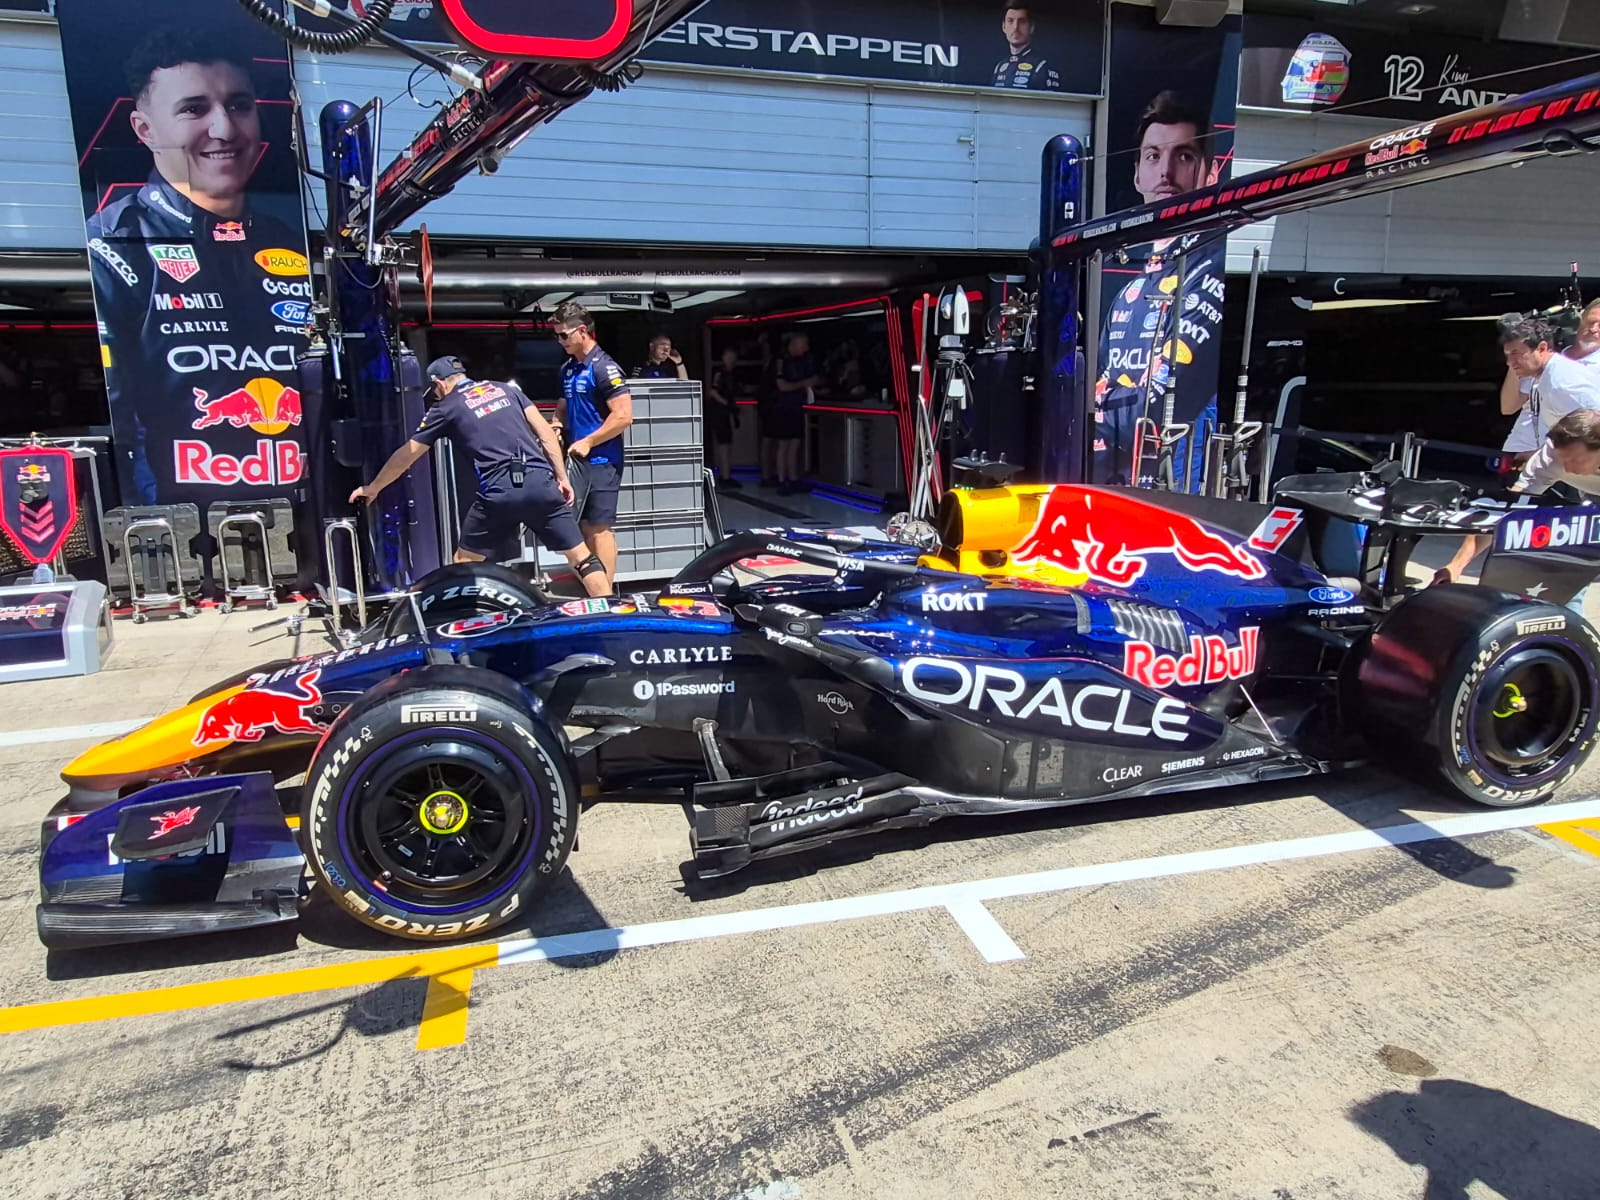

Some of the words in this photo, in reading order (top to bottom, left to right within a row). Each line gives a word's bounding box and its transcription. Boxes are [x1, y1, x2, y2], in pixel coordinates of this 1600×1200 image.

[655, 20, 959, 67] ERSTAPPEN
[1384, 55, 1425, 101] 12
[1438, 54, 1469, 87] Kimi
[1369, 122, 1438, 150] ORACLE
[1365, 156, 1431, 179] RACING
[88, 238, 139, 287] sparco
[156, 247, 191, 260] TAG
[160, 260, 197, 281] HEUER
[277, 280, 312, 297] Gat
[154, 293, 205, 310] Mobil
[1197, 301, 1223, 324] AT&T
[159, 320, 230, 335] CARLYLE
[166, 344, 298, 374] ORACL
[173, 439, 276, 485] Red
[1503, 515, 1588, 550] Mobil
[766, 543, 803, 557] DAMAC
[836, 557, 865, 572] VISA
[442, 585, 519, 606] ZERO
[921, 591, 988, 612] ROKT
[1318, 588, 1347, 601] Ford
[1307, 605, 1365, 616] RACING
[1516, 615, 1566, 636] PIRELLI
[630, 646, 733, 665] CARLYLE
[1123, 635, 1205, 689] Red
[1203, 626, 1261, 684] Bull
[657, 681, 736, 696] 1Password
[902, 656, 1191, 742] ORACLE
[401, 703, 479, 724] PIRELLI
[1231, 746, 1265, 760] HEXAGON
[1161, 756, 1206, 774] SIEMENS
[1482, 780, 1556, 801] ZERO
[760, 786, 864, 832] indeed
[500, 892, 520, 918] P
[374, 912, 491, 937] ZERO
